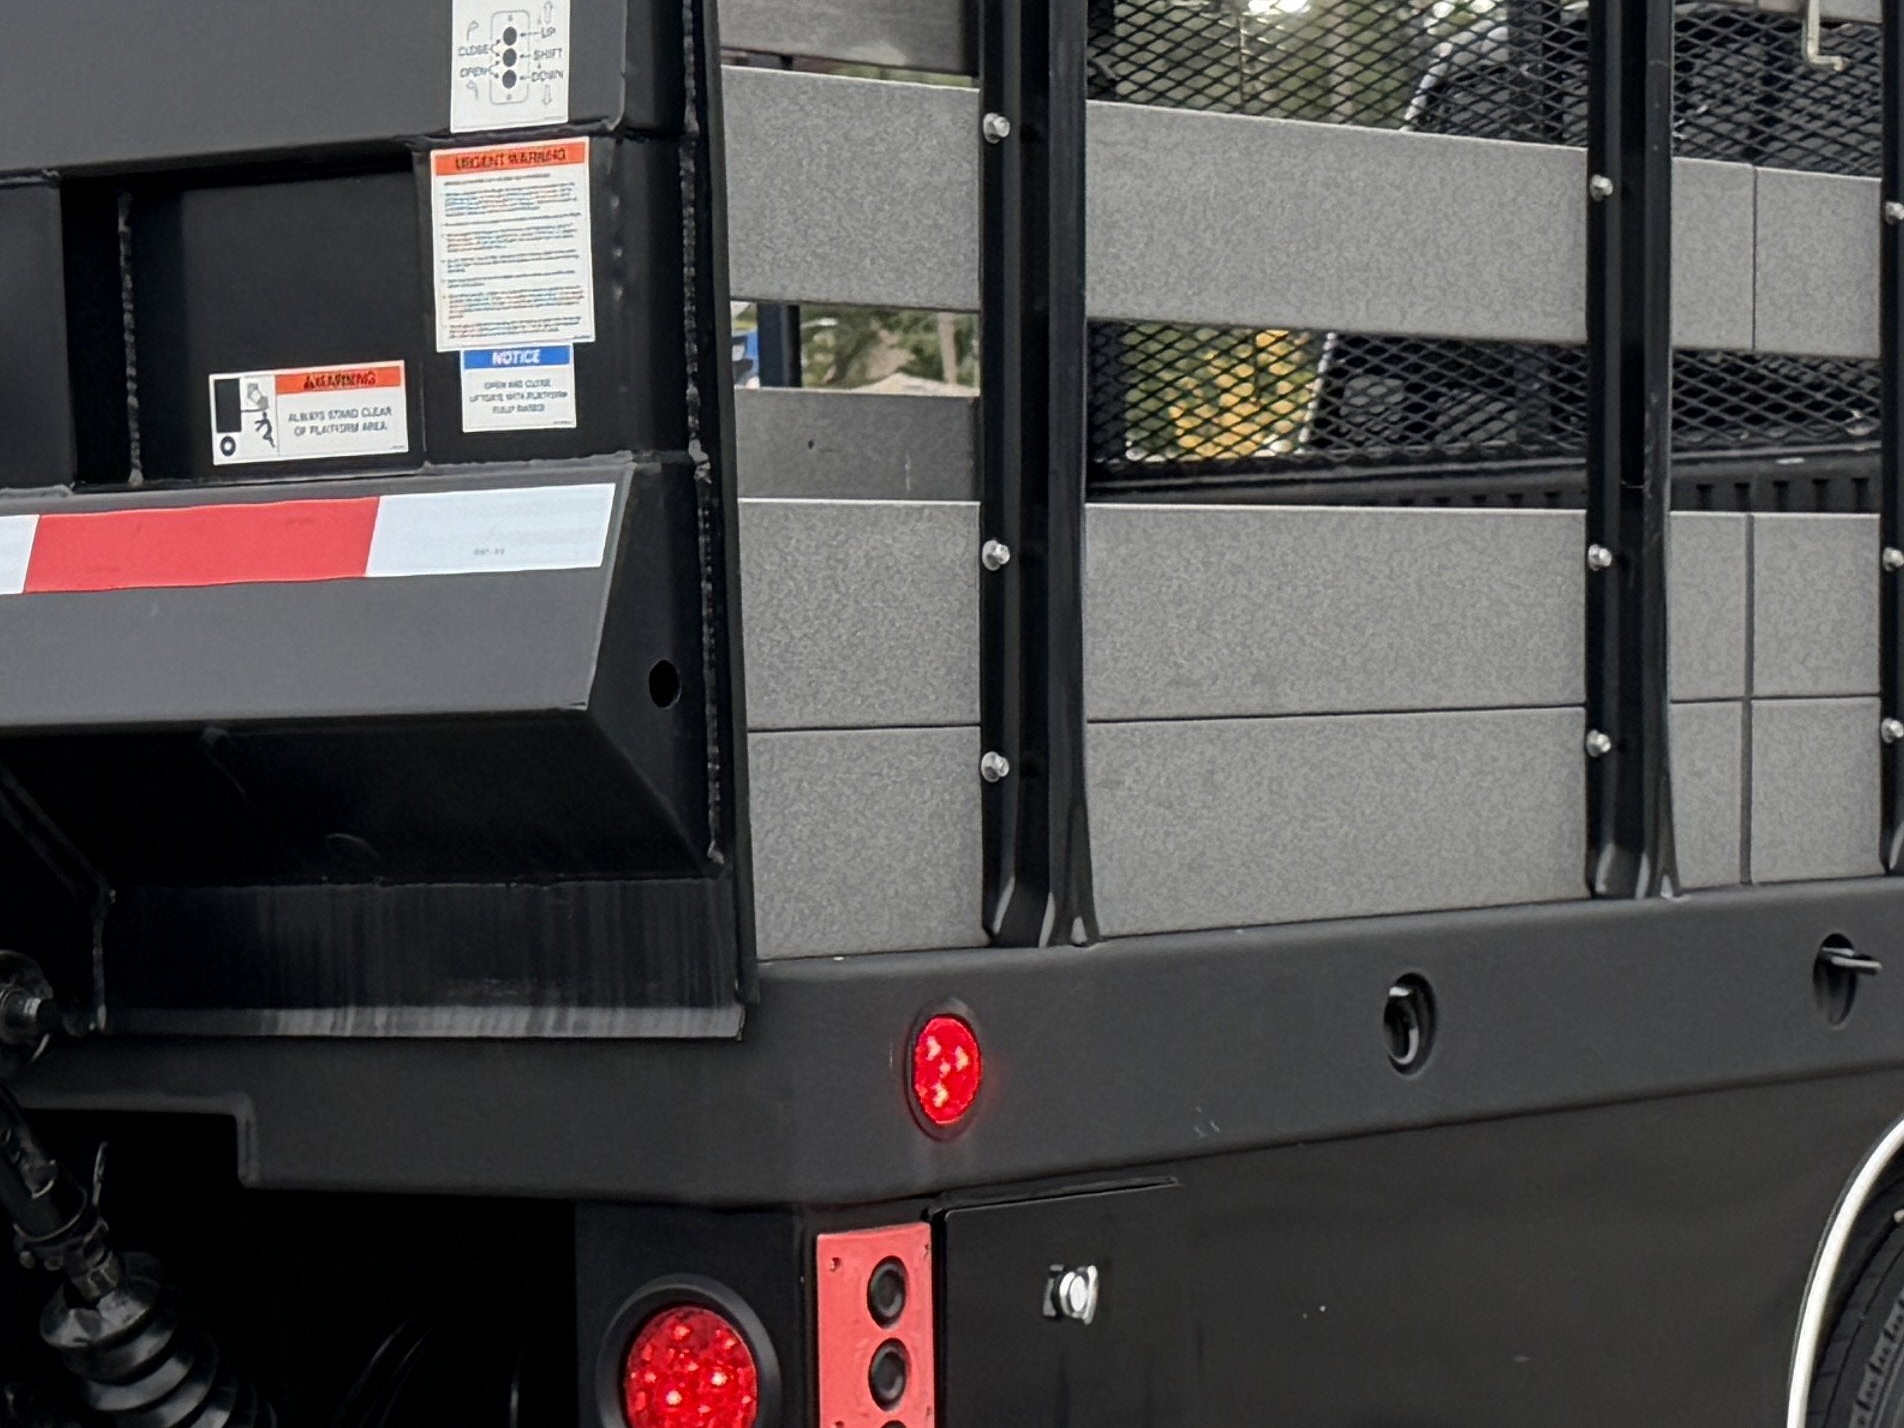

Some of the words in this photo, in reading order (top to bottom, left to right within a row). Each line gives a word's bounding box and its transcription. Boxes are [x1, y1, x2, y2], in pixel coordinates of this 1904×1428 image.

[458, 44, 489, 56] CLOSE
[533, 47, 563, 61] SHIFT
[531, 70, 563, 82] DOWN
[456, 154, 505, 170] URGENT
[508, 148, 566, 165] WARNING
[492, 349, 541, 365] NOTICE
[315, 371, 377, 388] WARNING
[328, 409, 359, 420] STAND
[361, 406, 392, 418] CLEAR
[309, 422, 359, 435] PLATFORM
[362, 420, 387, 432] AREA
